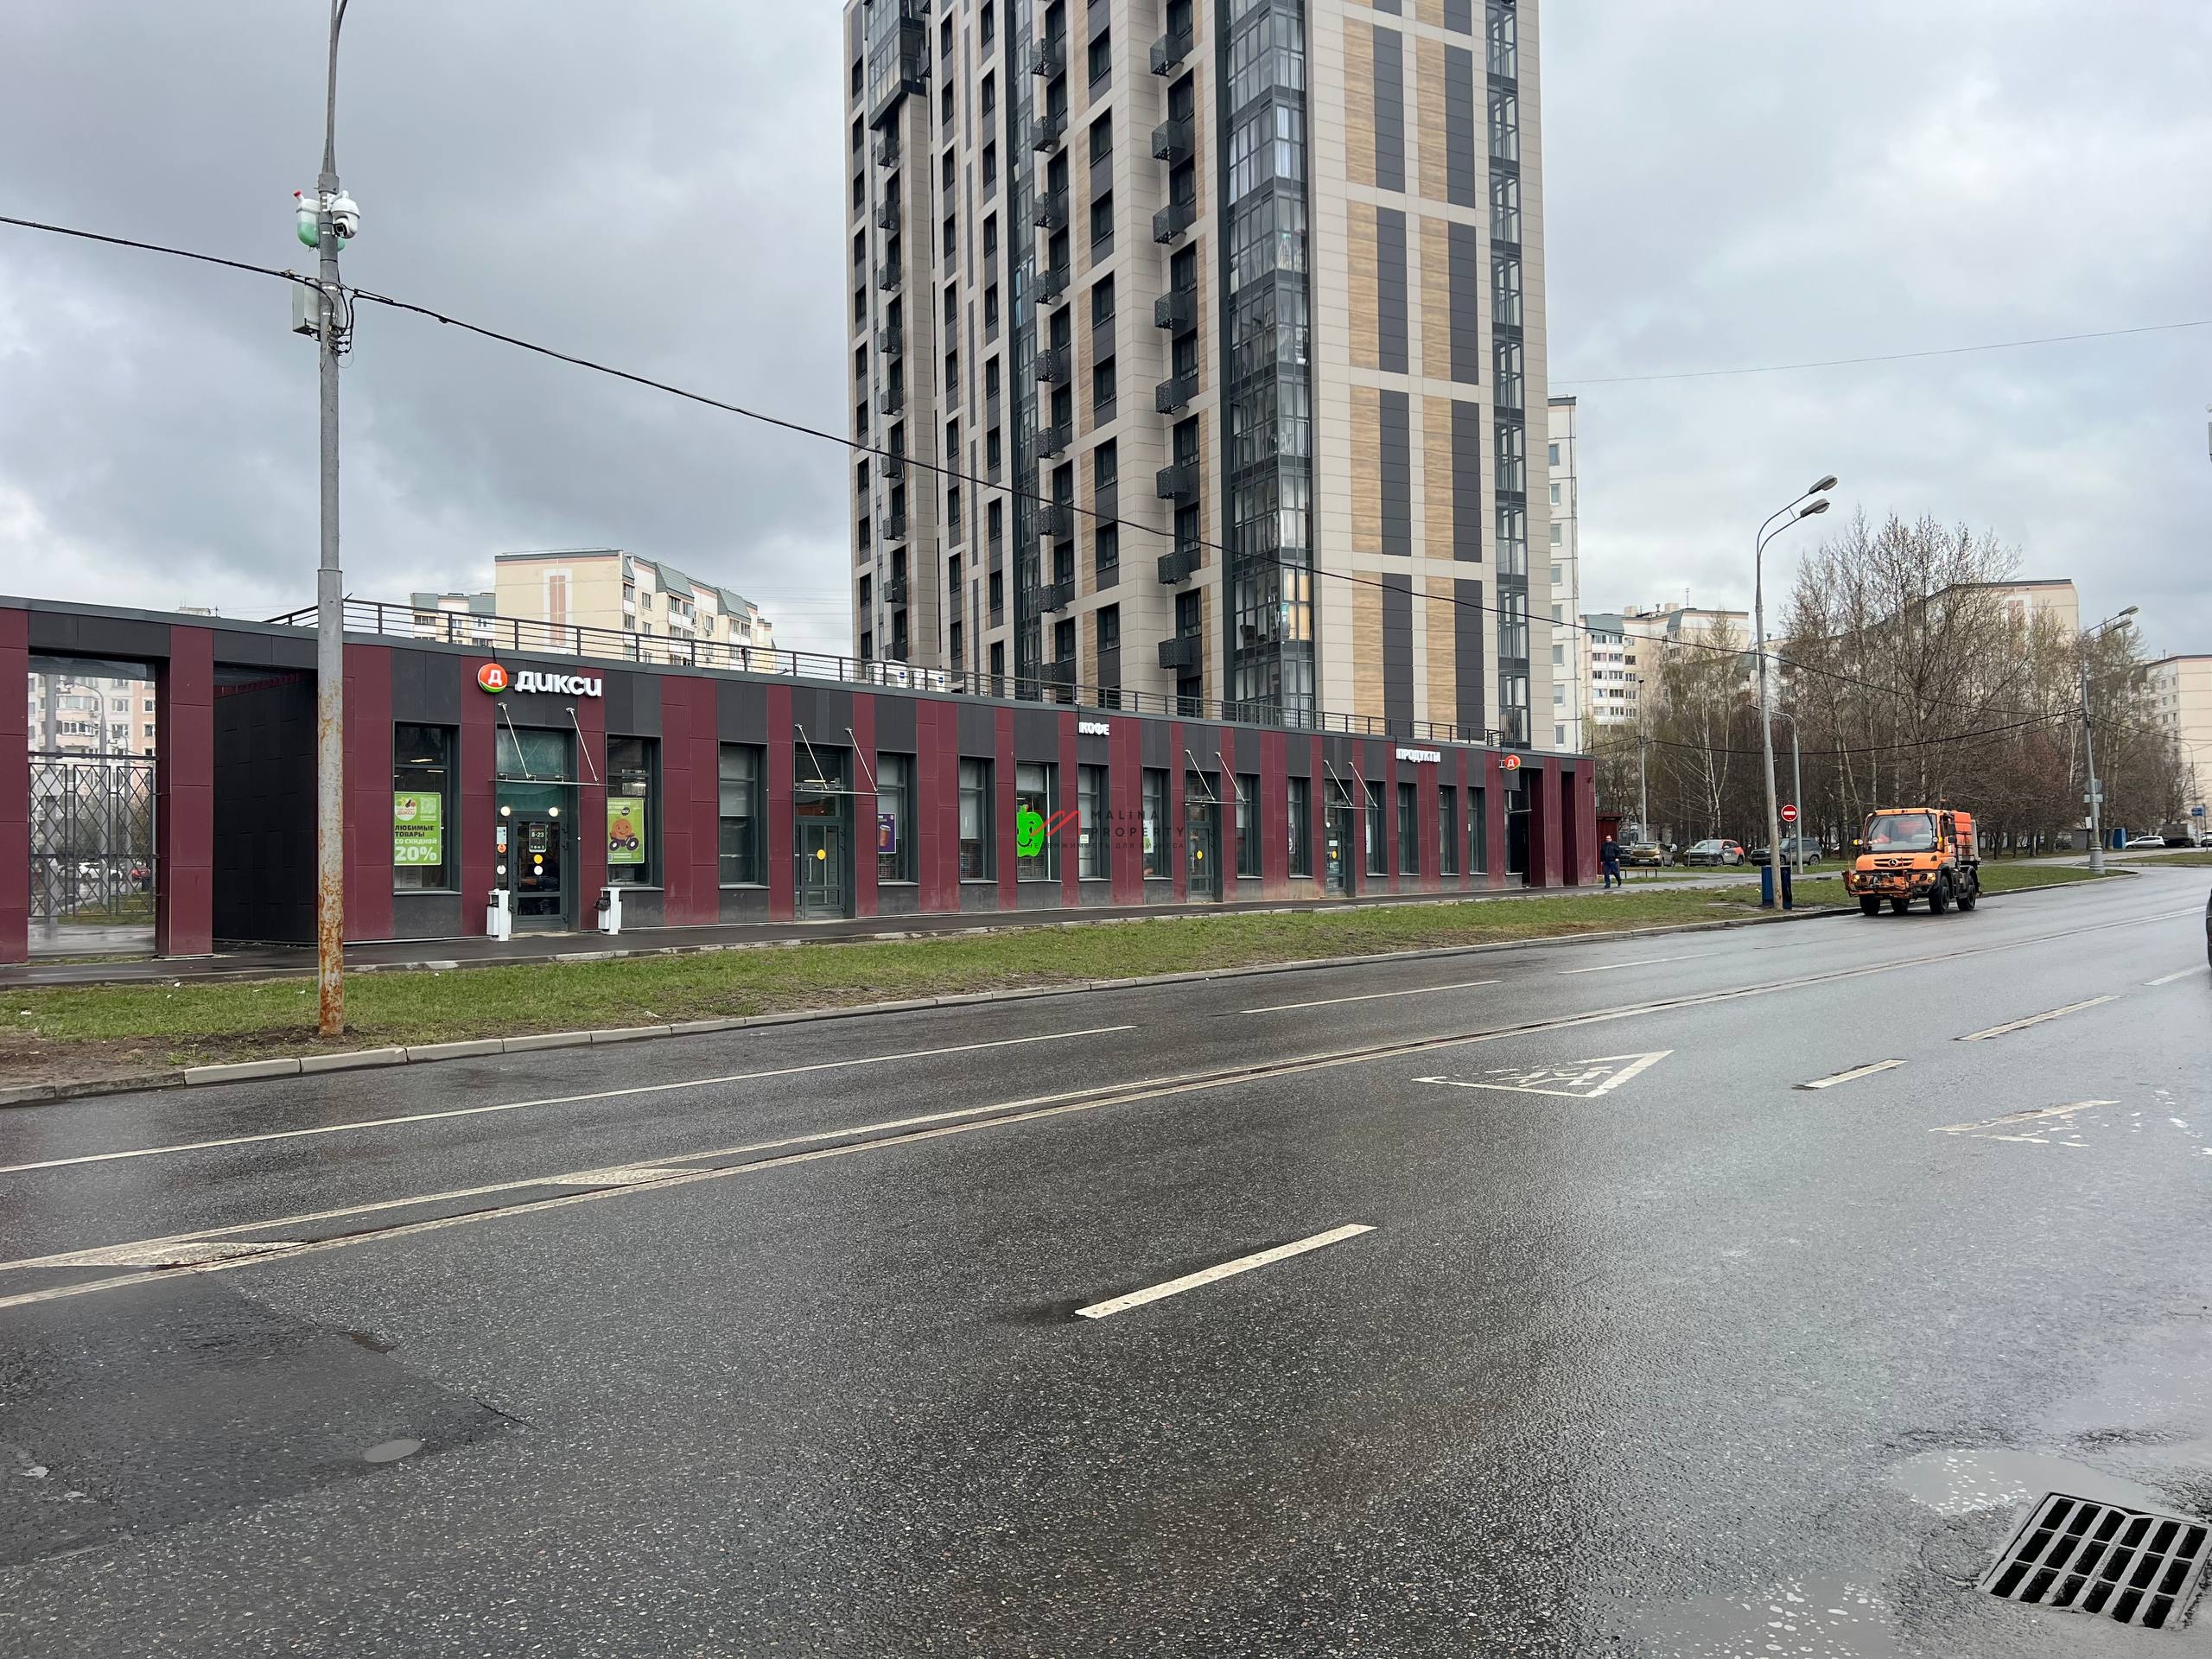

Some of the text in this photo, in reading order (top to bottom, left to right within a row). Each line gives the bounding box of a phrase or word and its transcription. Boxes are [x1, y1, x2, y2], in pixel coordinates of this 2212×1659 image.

[487, 670, 502, 686] Д
[1078, 721, 1110, 736] КОФЕ
[1395, 748, 1441, 763] ПРОДУКТЫ
[395, 846, 437, 861] 20%
